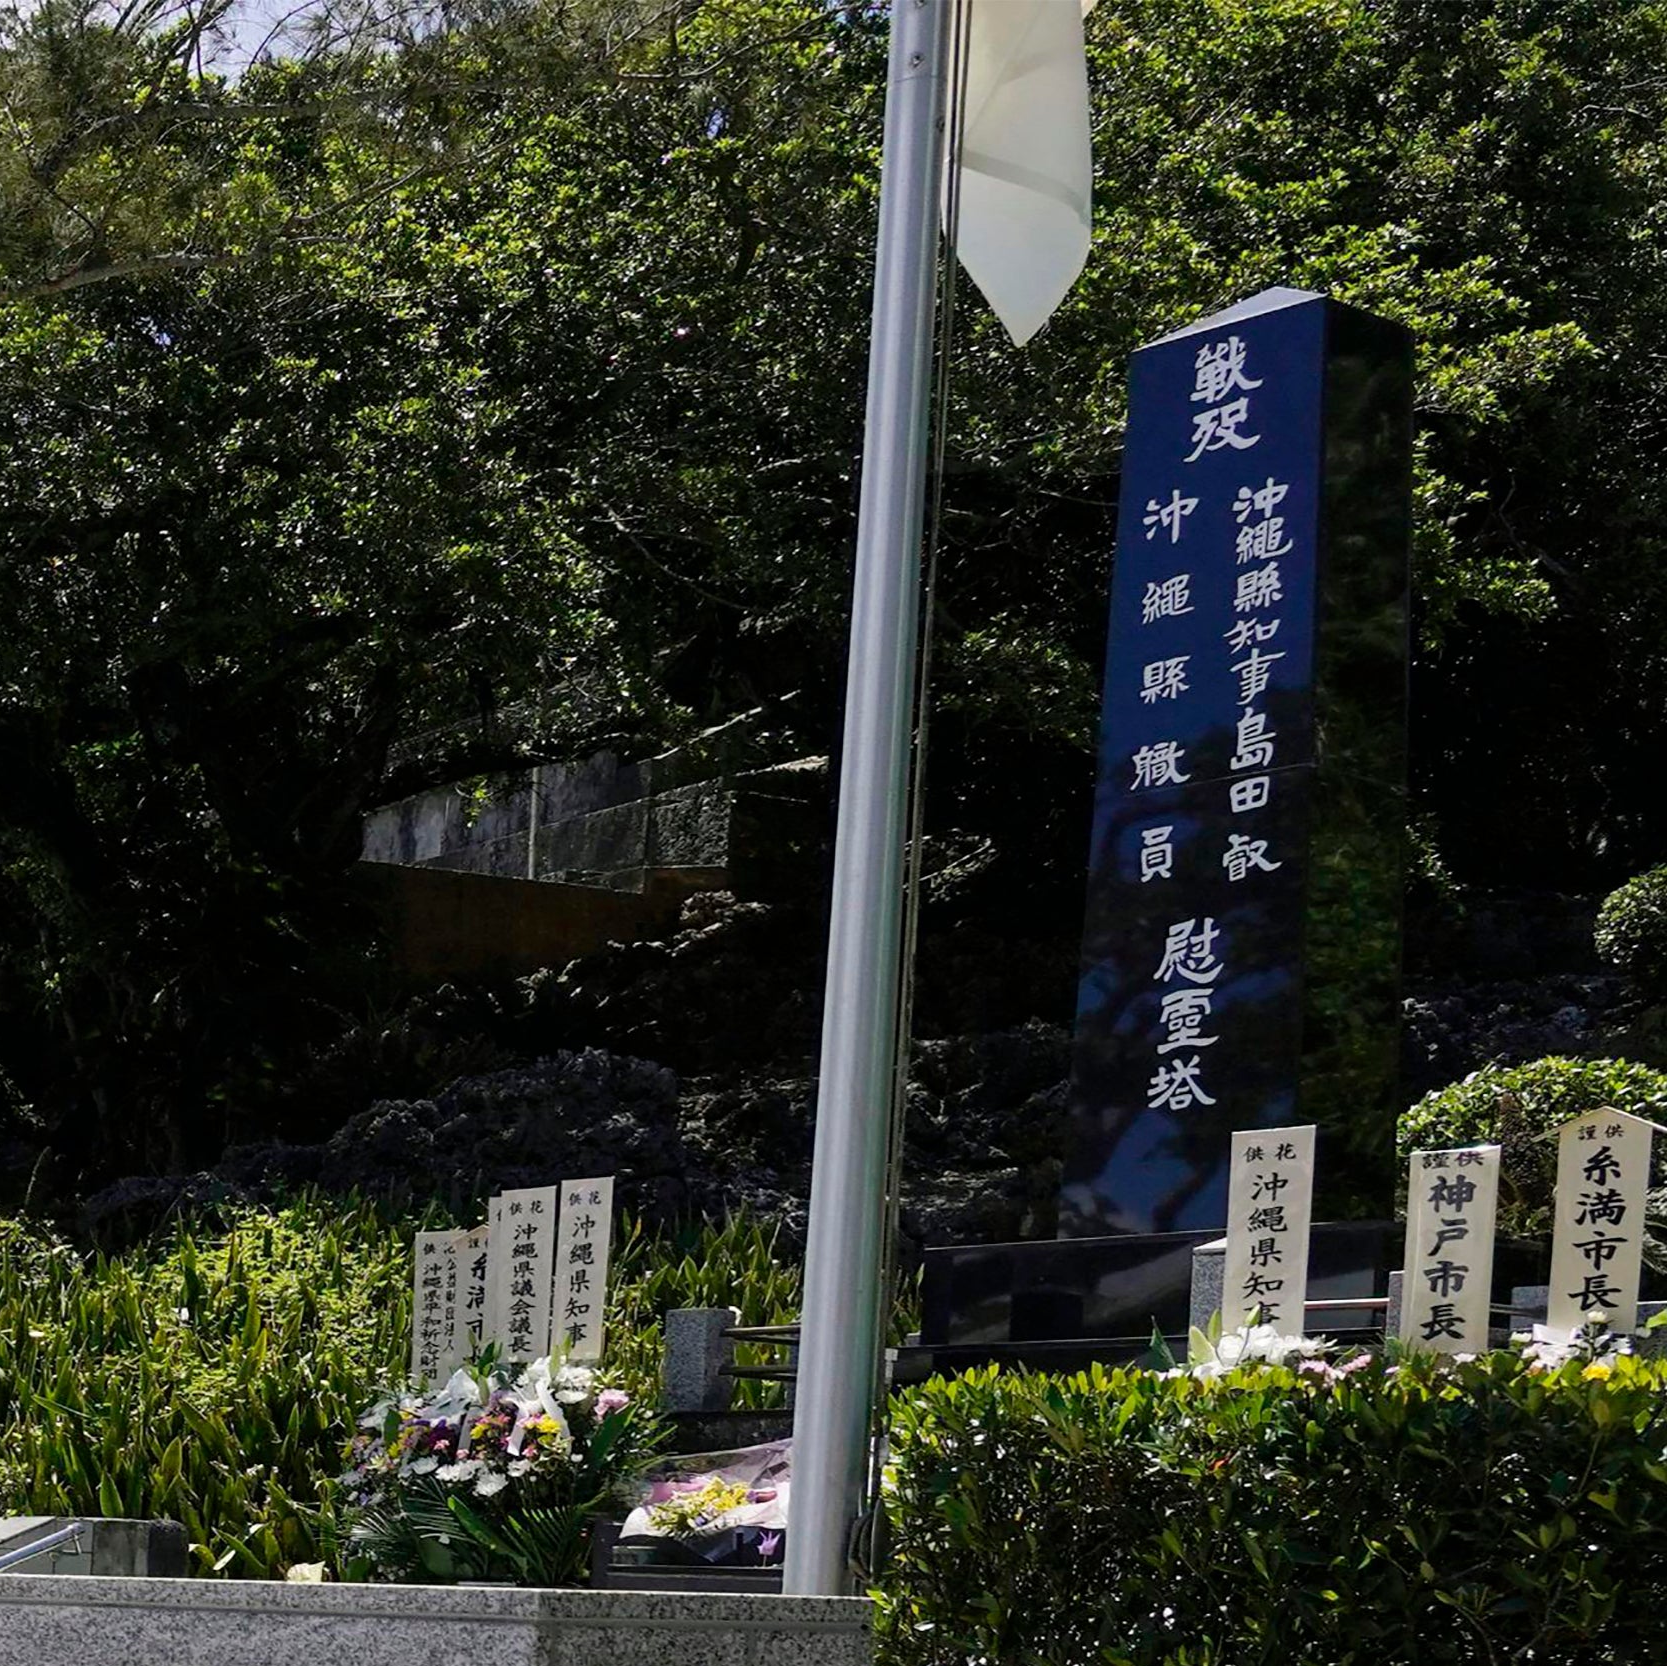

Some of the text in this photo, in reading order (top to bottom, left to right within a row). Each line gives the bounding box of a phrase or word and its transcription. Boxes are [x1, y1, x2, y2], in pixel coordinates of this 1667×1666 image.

[1420, 1174, 1477, 1340] 神戸市長
[1568, 1146, 1628, 1310] 糸満市長
